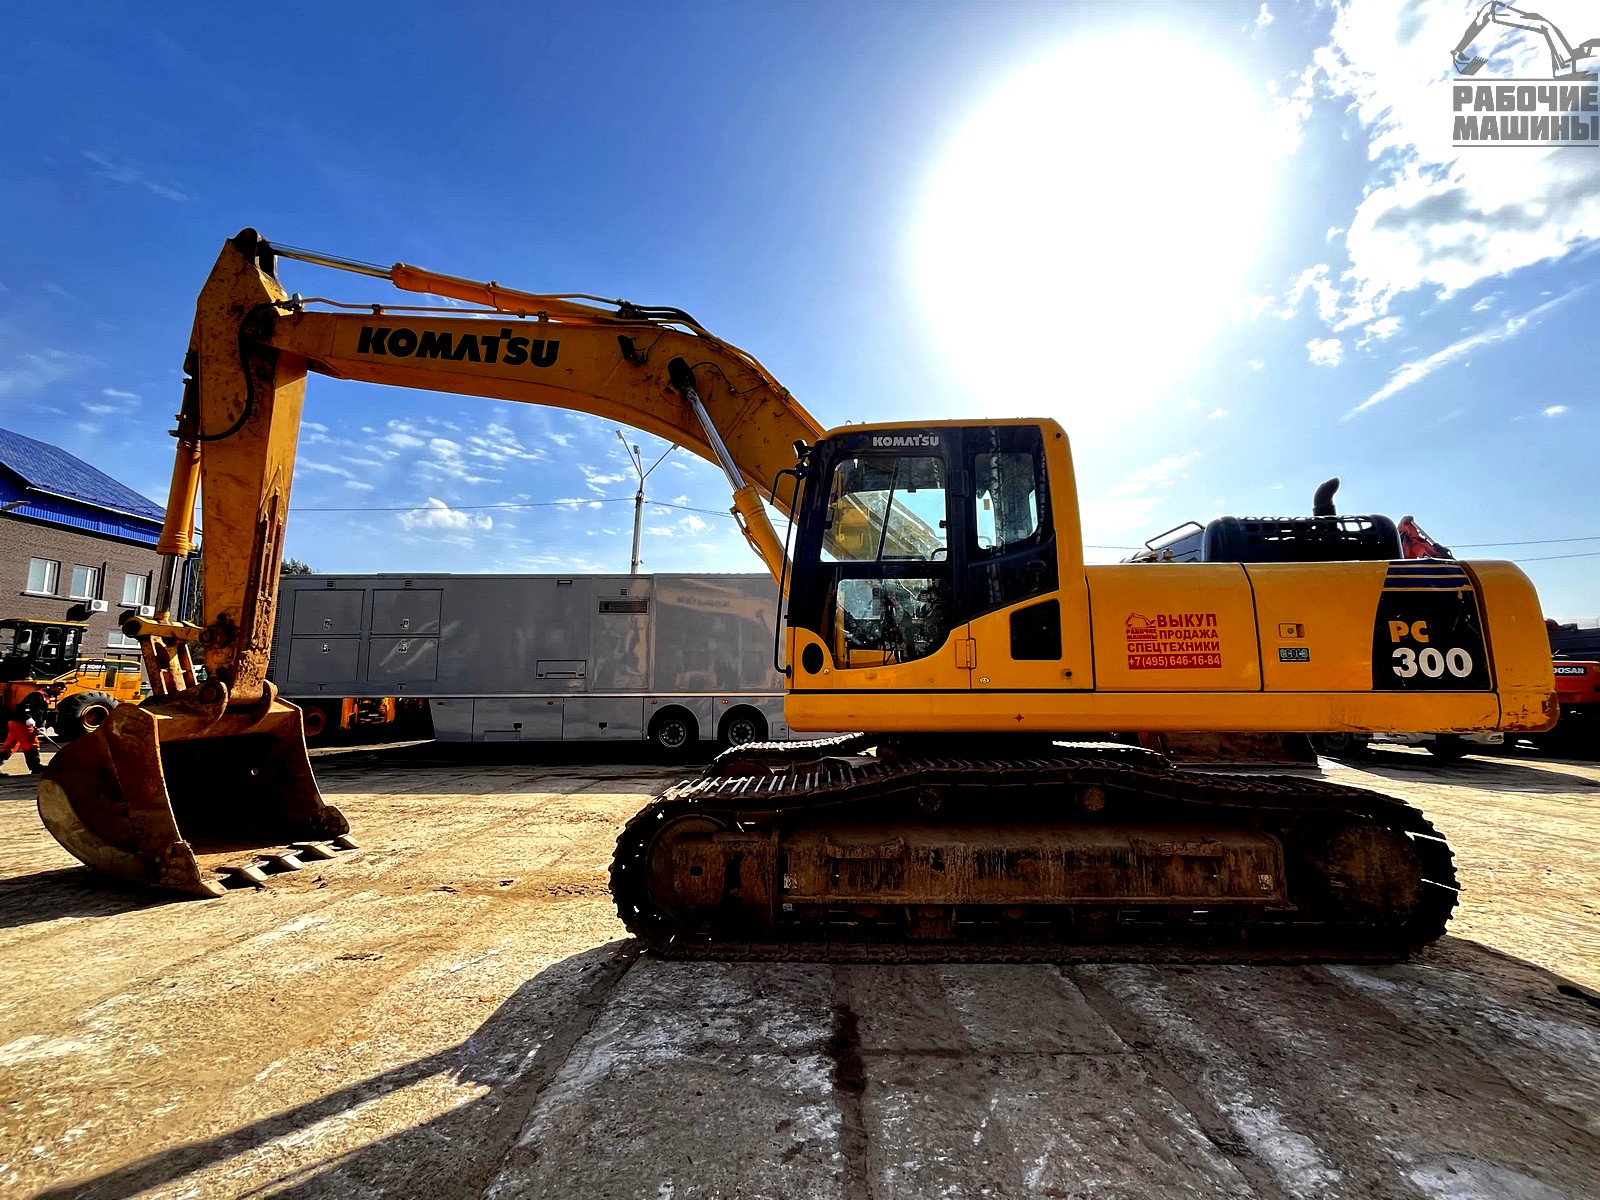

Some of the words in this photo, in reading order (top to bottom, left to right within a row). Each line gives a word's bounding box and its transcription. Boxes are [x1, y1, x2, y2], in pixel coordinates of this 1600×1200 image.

[356, 326, 560, 368] KOMATSU
[872, 433, 939, 447] KOMATSU
[1157, 613, 1217, 628] ВЫКУП
[1159, 629, 1219, 640] ПРОДАЖА
[1388, 620, 1430, 643] PC
[1127, 641, 1220, 654] СПЕЦТЕХНИКИ
[1392, 647, 1473, 678] 300
